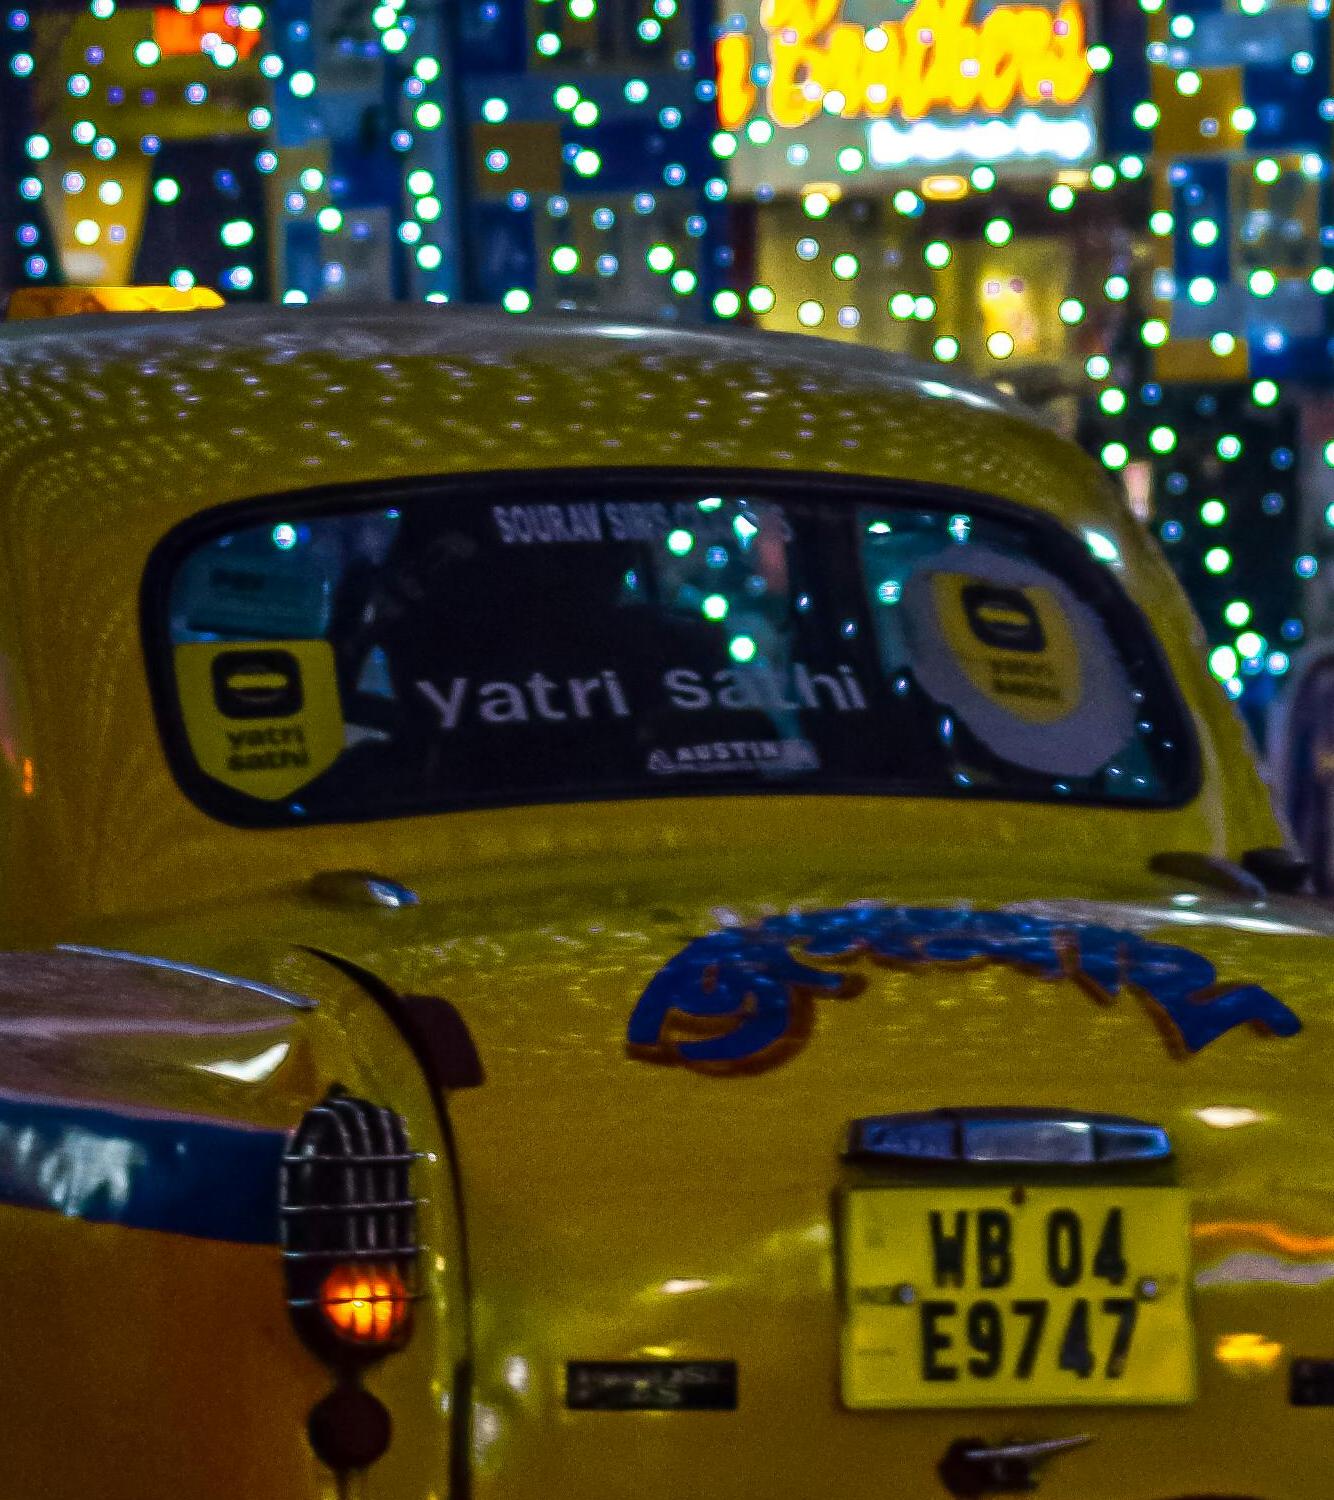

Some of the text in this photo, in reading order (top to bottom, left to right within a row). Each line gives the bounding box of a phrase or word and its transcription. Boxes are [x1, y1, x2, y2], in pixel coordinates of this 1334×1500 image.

[416, 662, 867, 729] yatri sathi
[930, 1208, 1128, 1288] WB 04
[921, 1299, 1139, 1381] E9747
